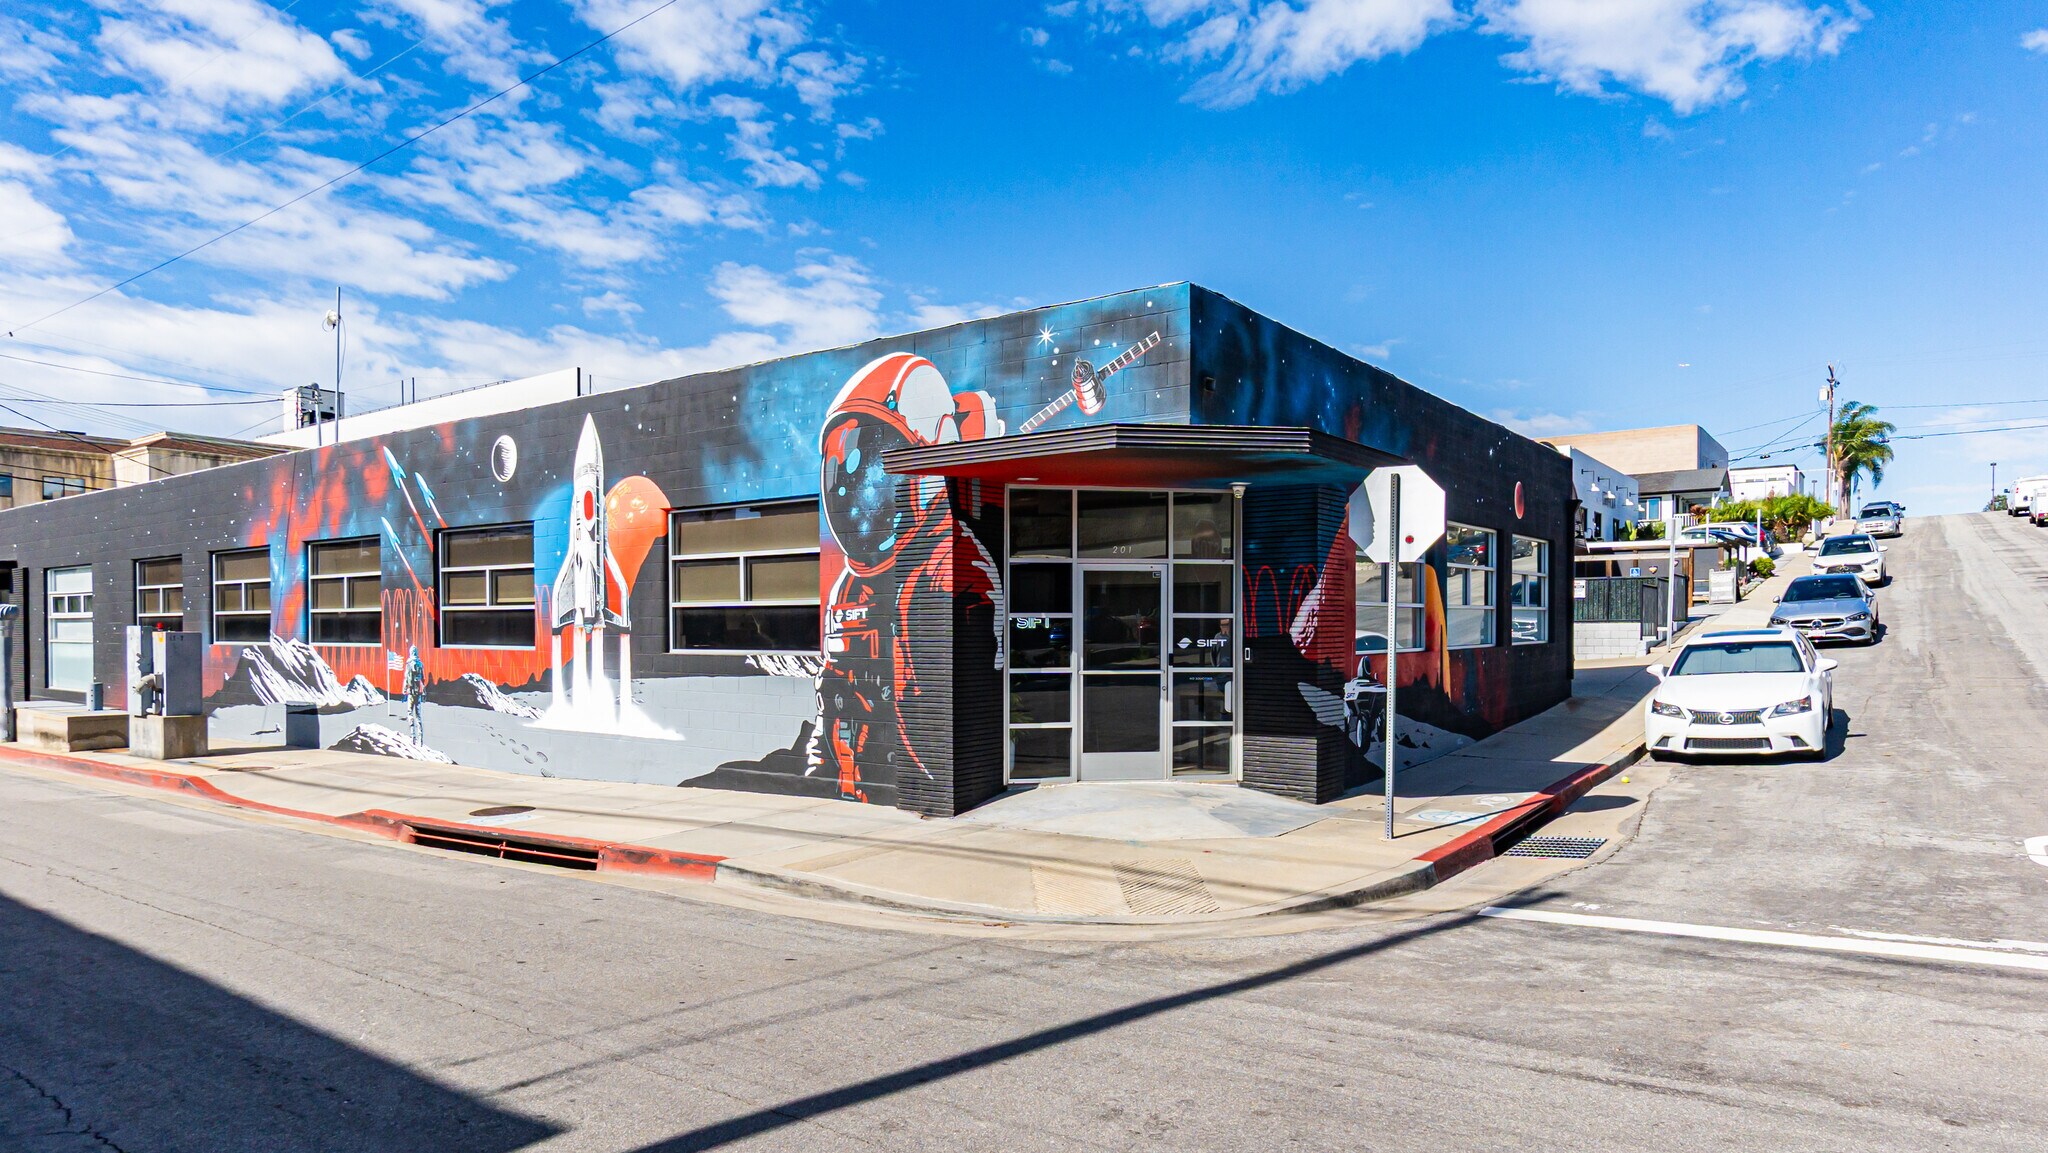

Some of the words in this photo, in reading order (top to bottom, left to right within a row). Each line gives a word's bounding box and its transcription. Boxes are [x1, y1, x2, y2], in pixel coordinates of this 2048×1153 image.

[1112, 545, 1132, 554] 201
[845, 607, 868, 620] SIFT
[1196, 638, 1227, 648] SIFT
